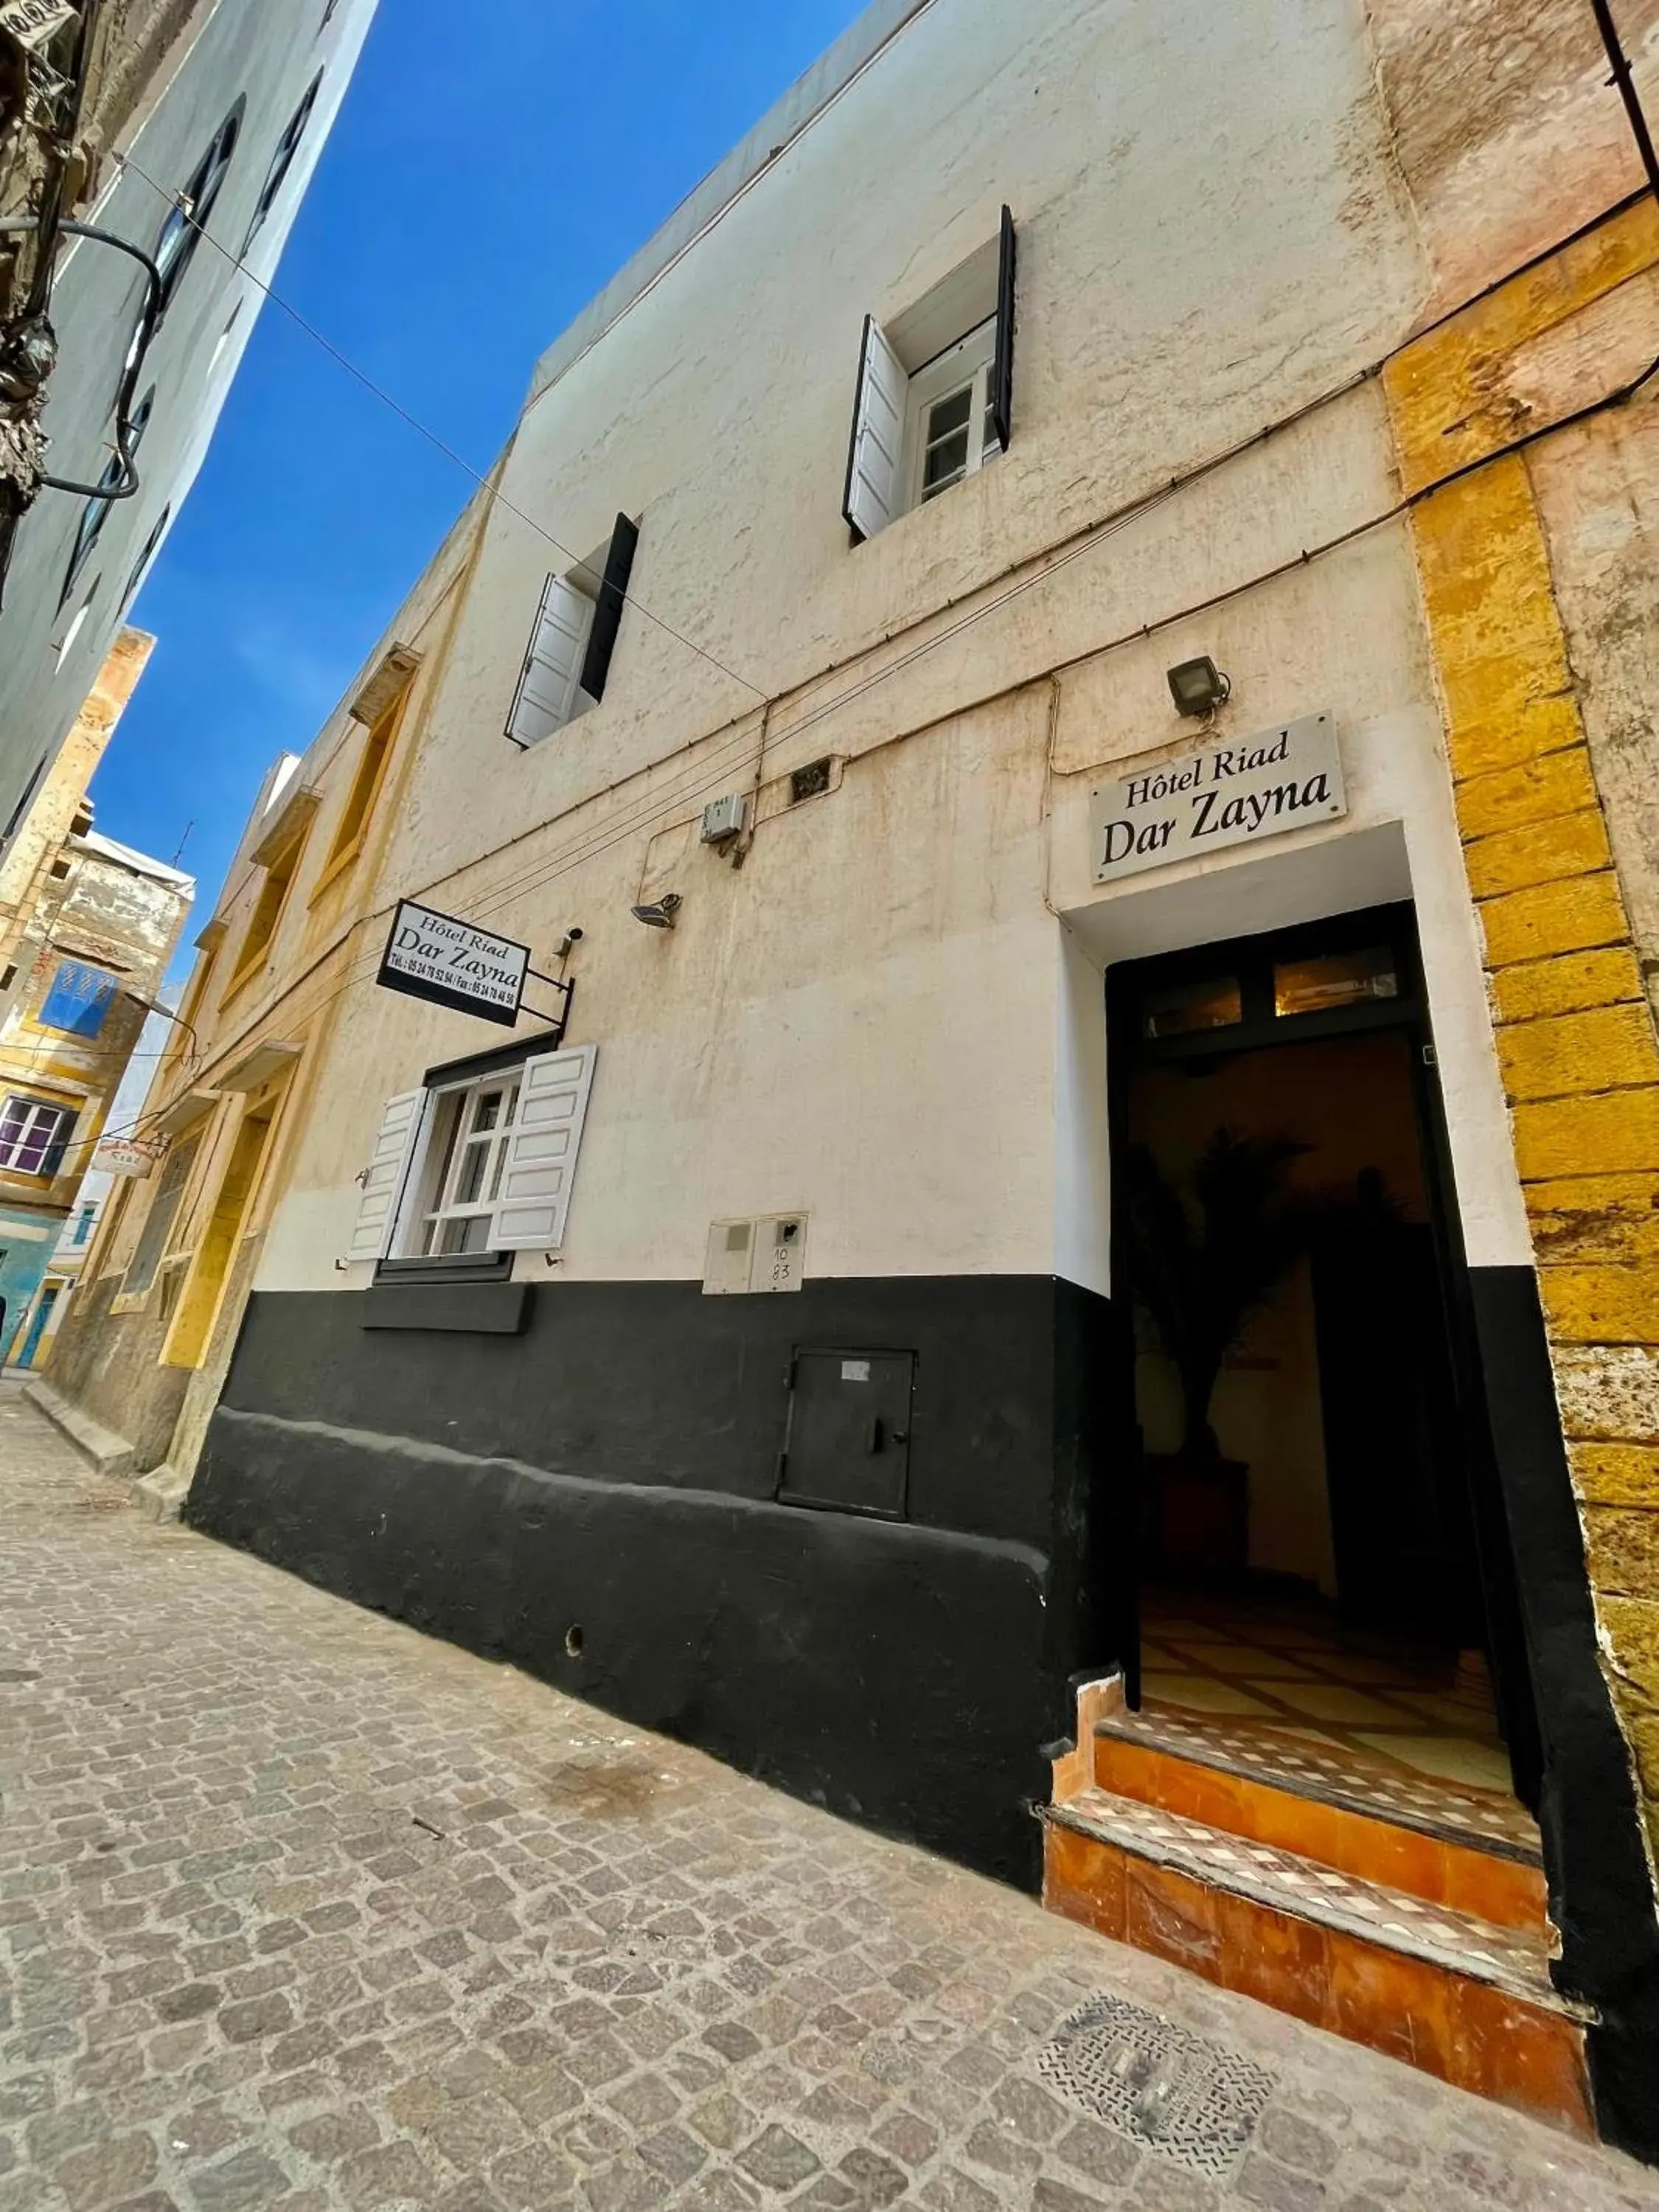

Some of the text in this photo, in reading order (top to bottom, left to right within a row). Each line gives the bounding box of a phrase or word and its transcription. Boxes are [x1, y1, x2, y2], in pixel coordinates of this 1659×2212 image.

[1124, 730, 1290, 810] Hôtel Riad
[1101, 773, 1331, 866] Dar Zayna
[394, 927, 519, 987] Dar Zayna
[420, 916, 509, 959] Hôtel Riad
[772, 1264, 790, 1281] 83
